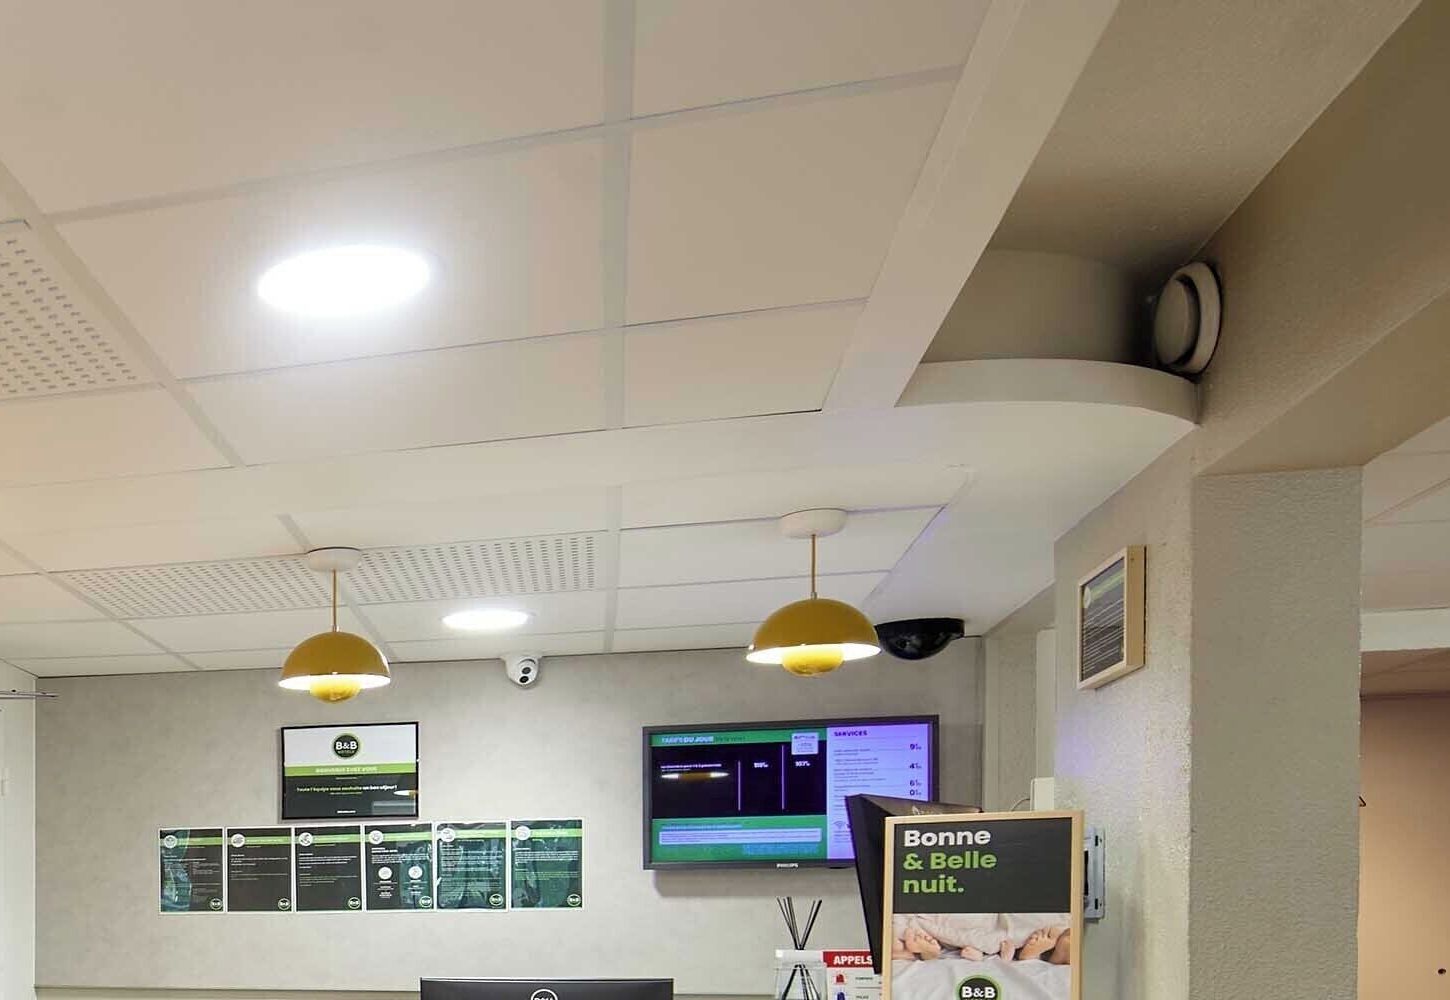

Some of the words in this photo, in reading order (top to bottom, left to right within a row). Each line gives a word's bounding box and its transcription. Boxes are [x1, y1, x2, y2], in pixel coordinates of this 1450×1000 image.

[335, 740, 358, 750] B&B
[903, 829, 991, 847] Bonne
[903, 853, 924, 870] &
[930, 850, 997, 870] Belle
[903, 874, 965, 894] nuit.
[833, 955, 873, 965] APPELS
[961, 986, 996, 998] B&B
